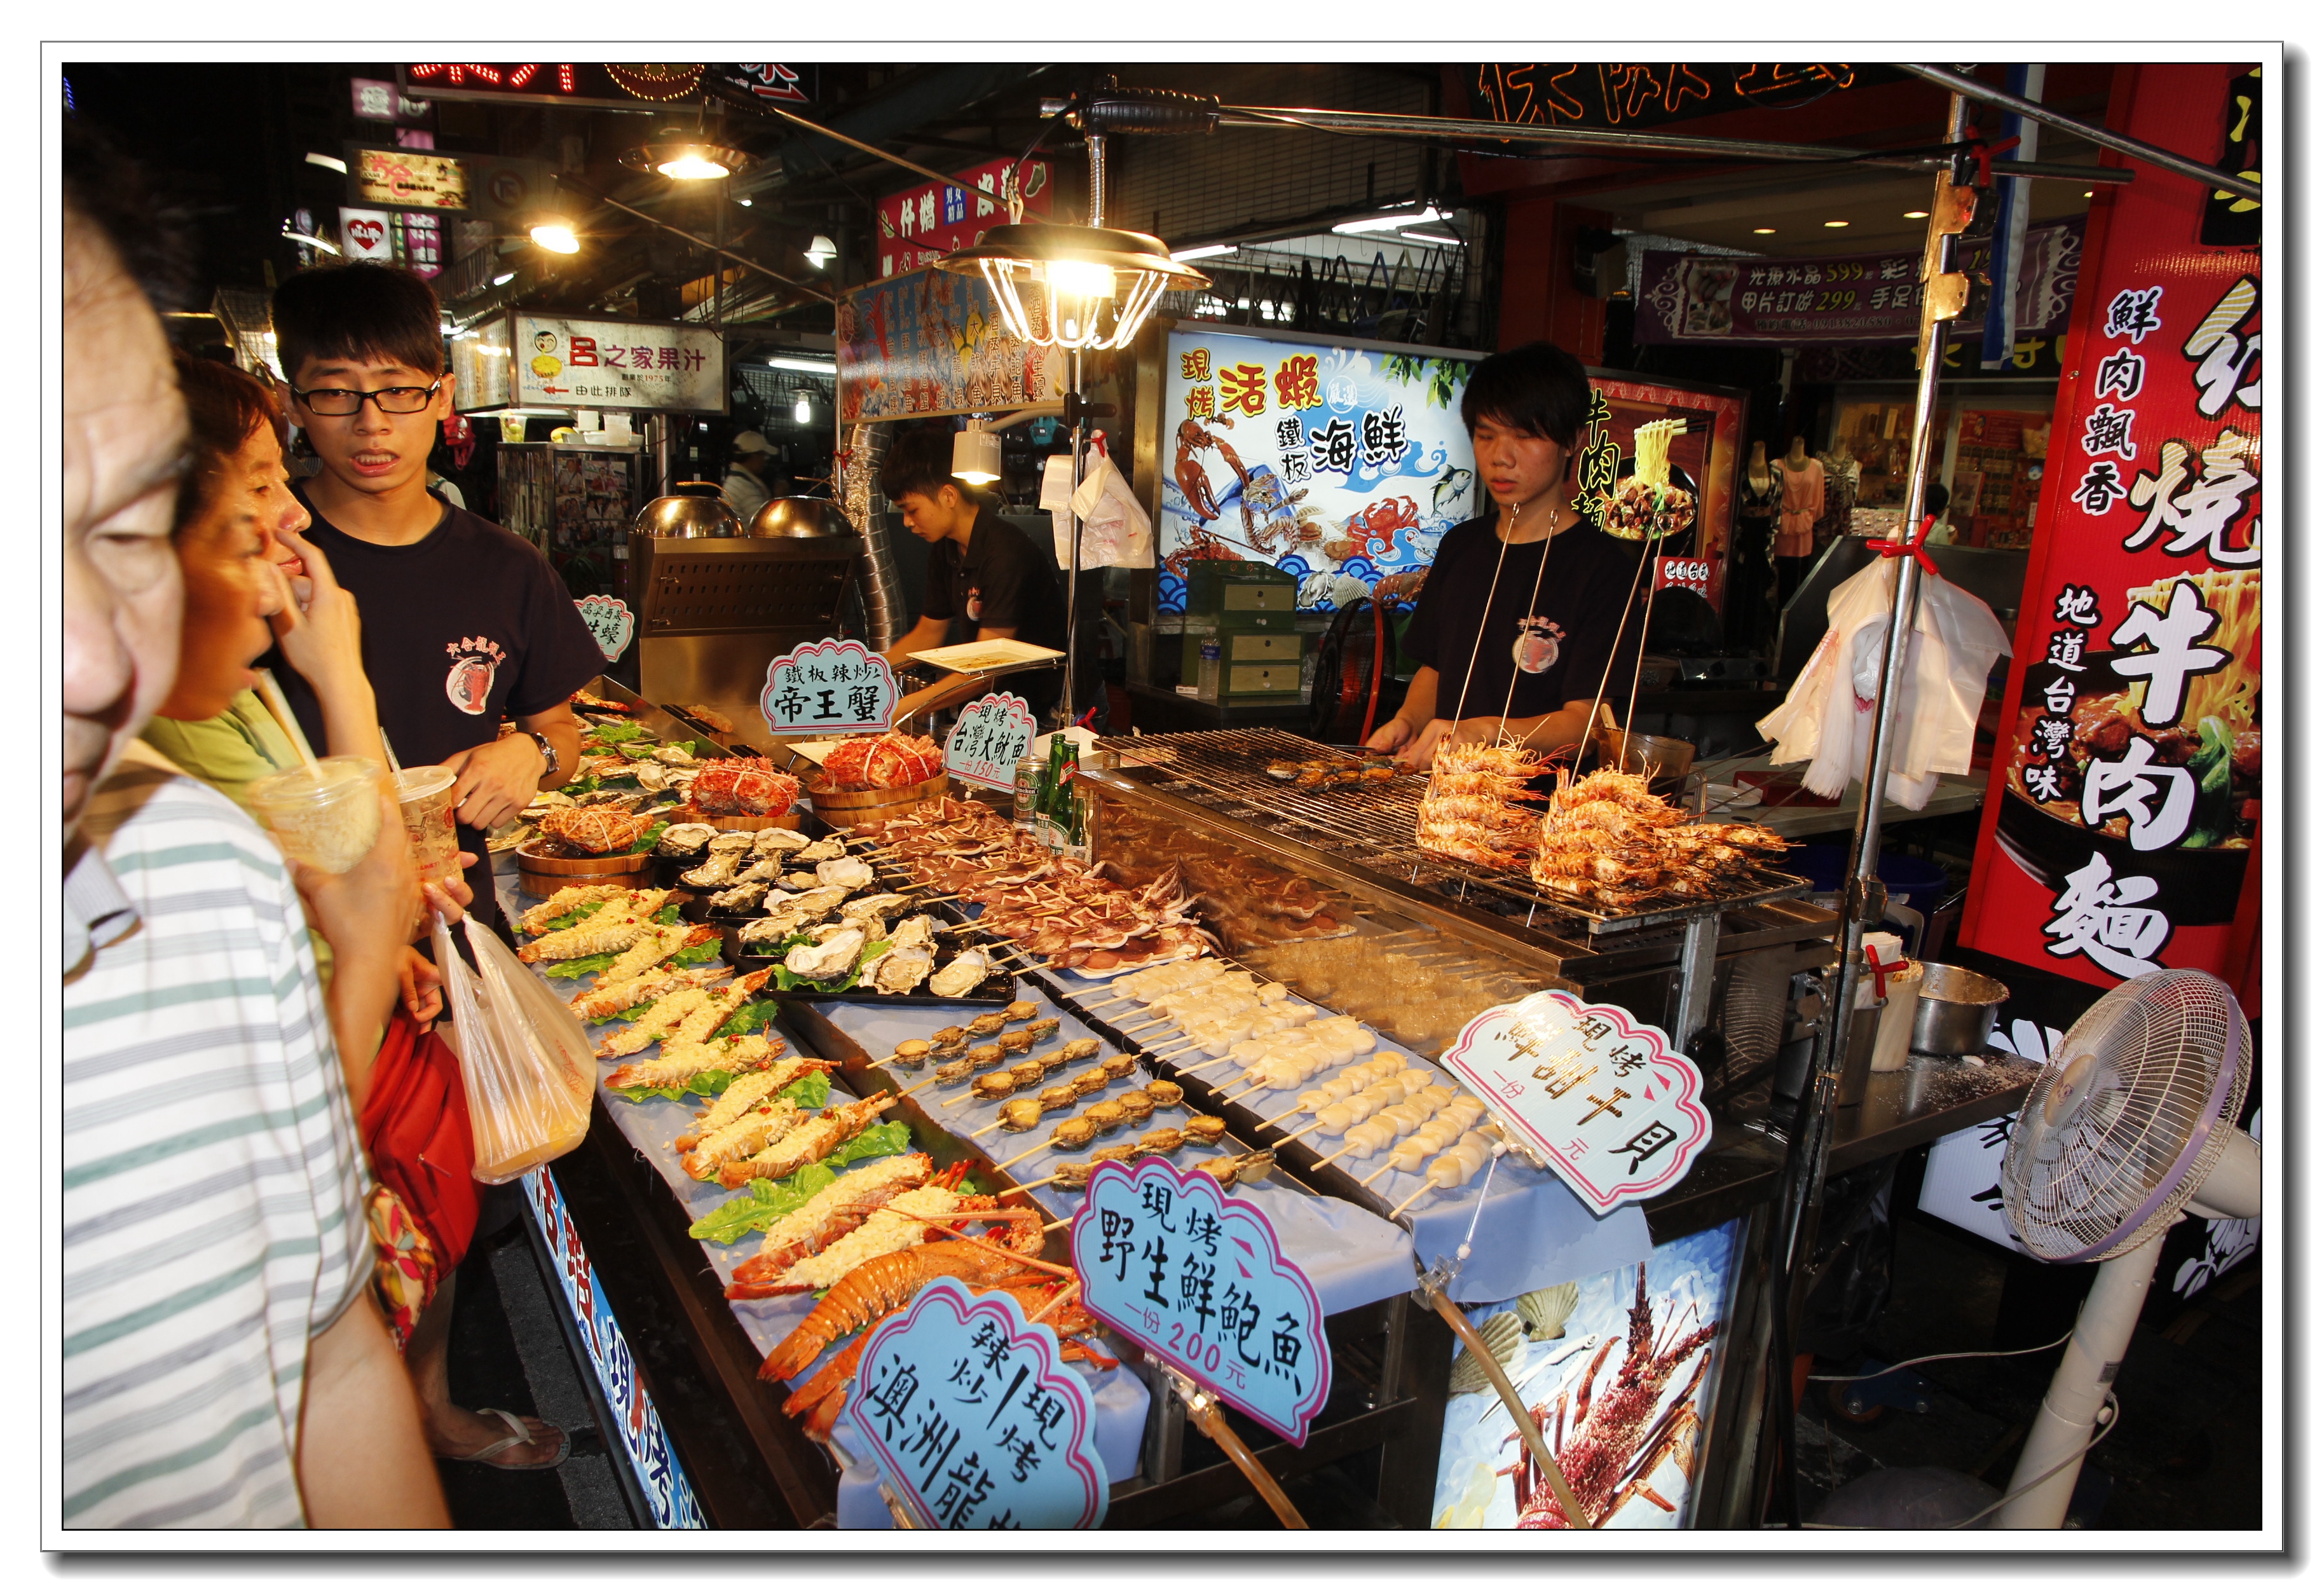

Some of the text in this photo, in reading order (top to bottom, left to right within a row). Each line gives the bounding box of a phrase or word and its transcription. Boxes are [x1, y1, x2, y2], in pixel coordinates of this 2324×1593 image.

[570, 336, 706, 371] 呂之家果汁
[1181, 348, 1323, 420] 現烤 活蝦
[575, 385, 632, 397] 由此排隊
[2072, 285, 2164, 516] 鮮肉飄香
[1275, 403, 1409, 484] 鐵板 海鮮
[775, 685, 880, 723] 帝王蟹
[785, 662, 882, 685] 鐵板辣炒
[2023, 583, 2102, 803] 地道台灣味
[979, 704, 1008, 727] 現烤
[1573, 1016, 1646, 1077] 現烤
[1143, 1182, 1222, 1258] 現烤
[1098, 1207, 1303, 1397] 野生鮮鮑魚
